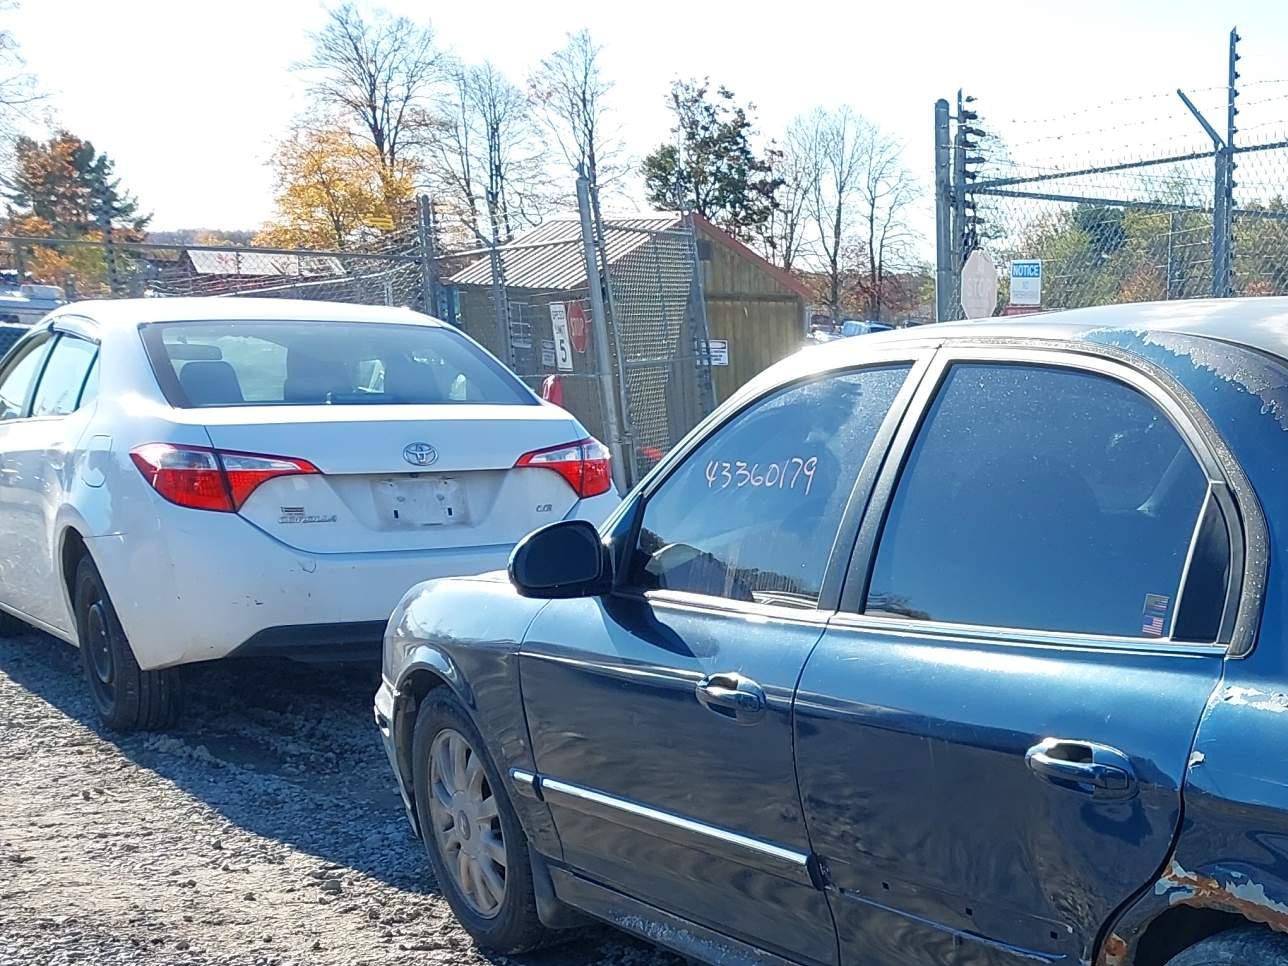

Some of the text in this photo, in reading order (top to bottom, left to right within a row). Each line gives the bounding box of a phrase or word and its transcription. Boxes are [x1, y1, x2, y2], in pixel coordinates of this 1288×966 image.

[1013, 265, 1039, 276] NOTICE
[559, 339, 567, 362] 5
[706, 456, 818, 496] 43360179
